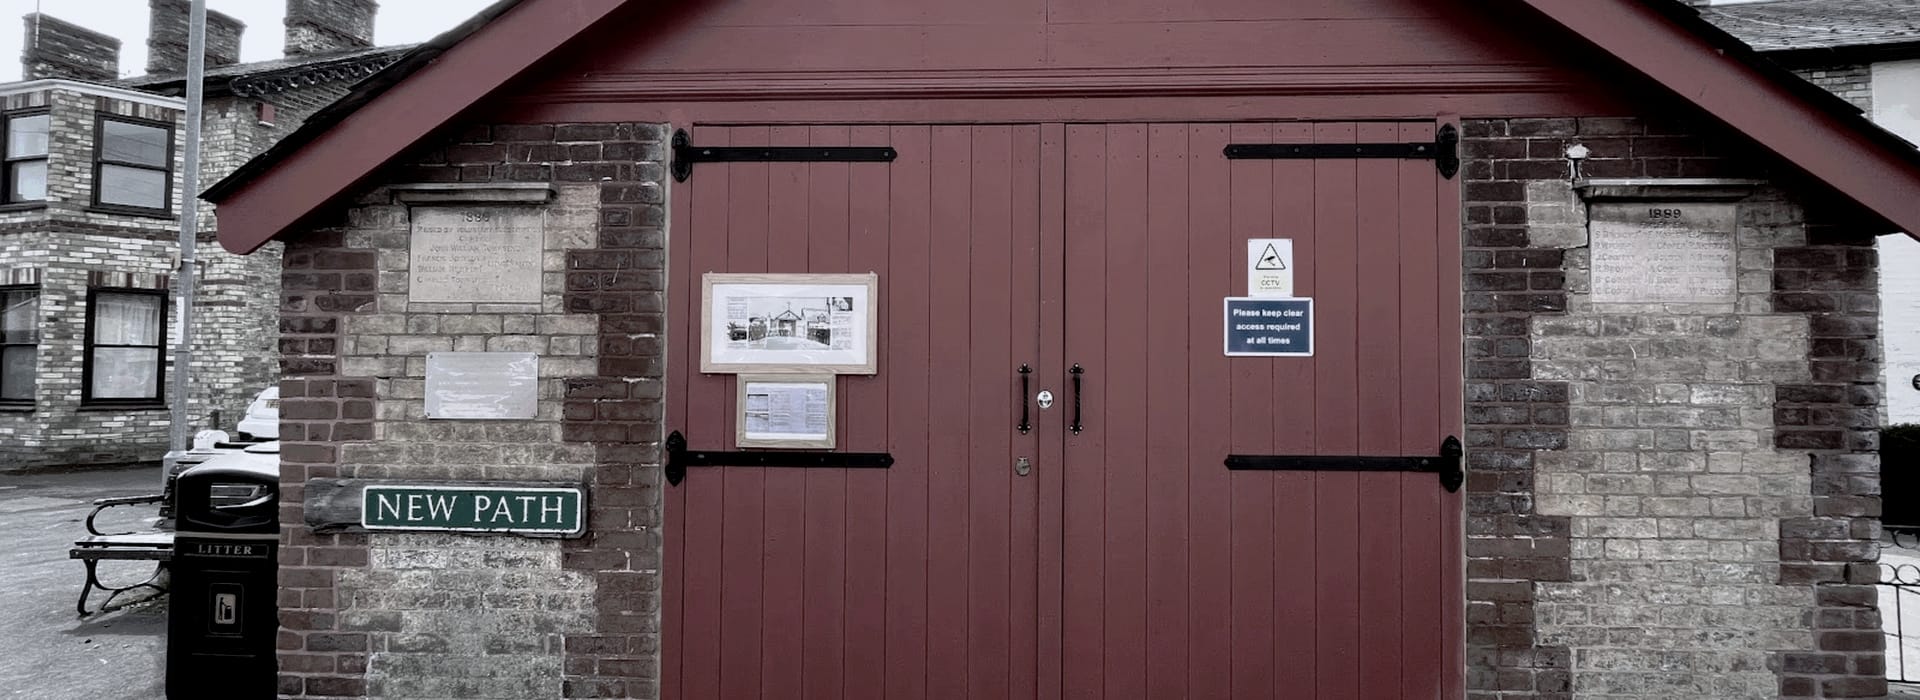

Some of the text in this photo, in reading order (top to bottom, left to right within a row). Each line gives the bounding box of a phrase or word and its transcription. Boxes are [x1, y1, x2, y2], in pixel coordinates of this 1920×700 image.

[1648, 208, 1682, 219] 1889
[1233, 309, 1304, 318] Please keep clear
[1266, 323, 1301, 332] required
[1256, 336, 1266, 344] all
[377, 493, 564, 523] NEW PATH
[198, 544, 252, 555] LITTER
